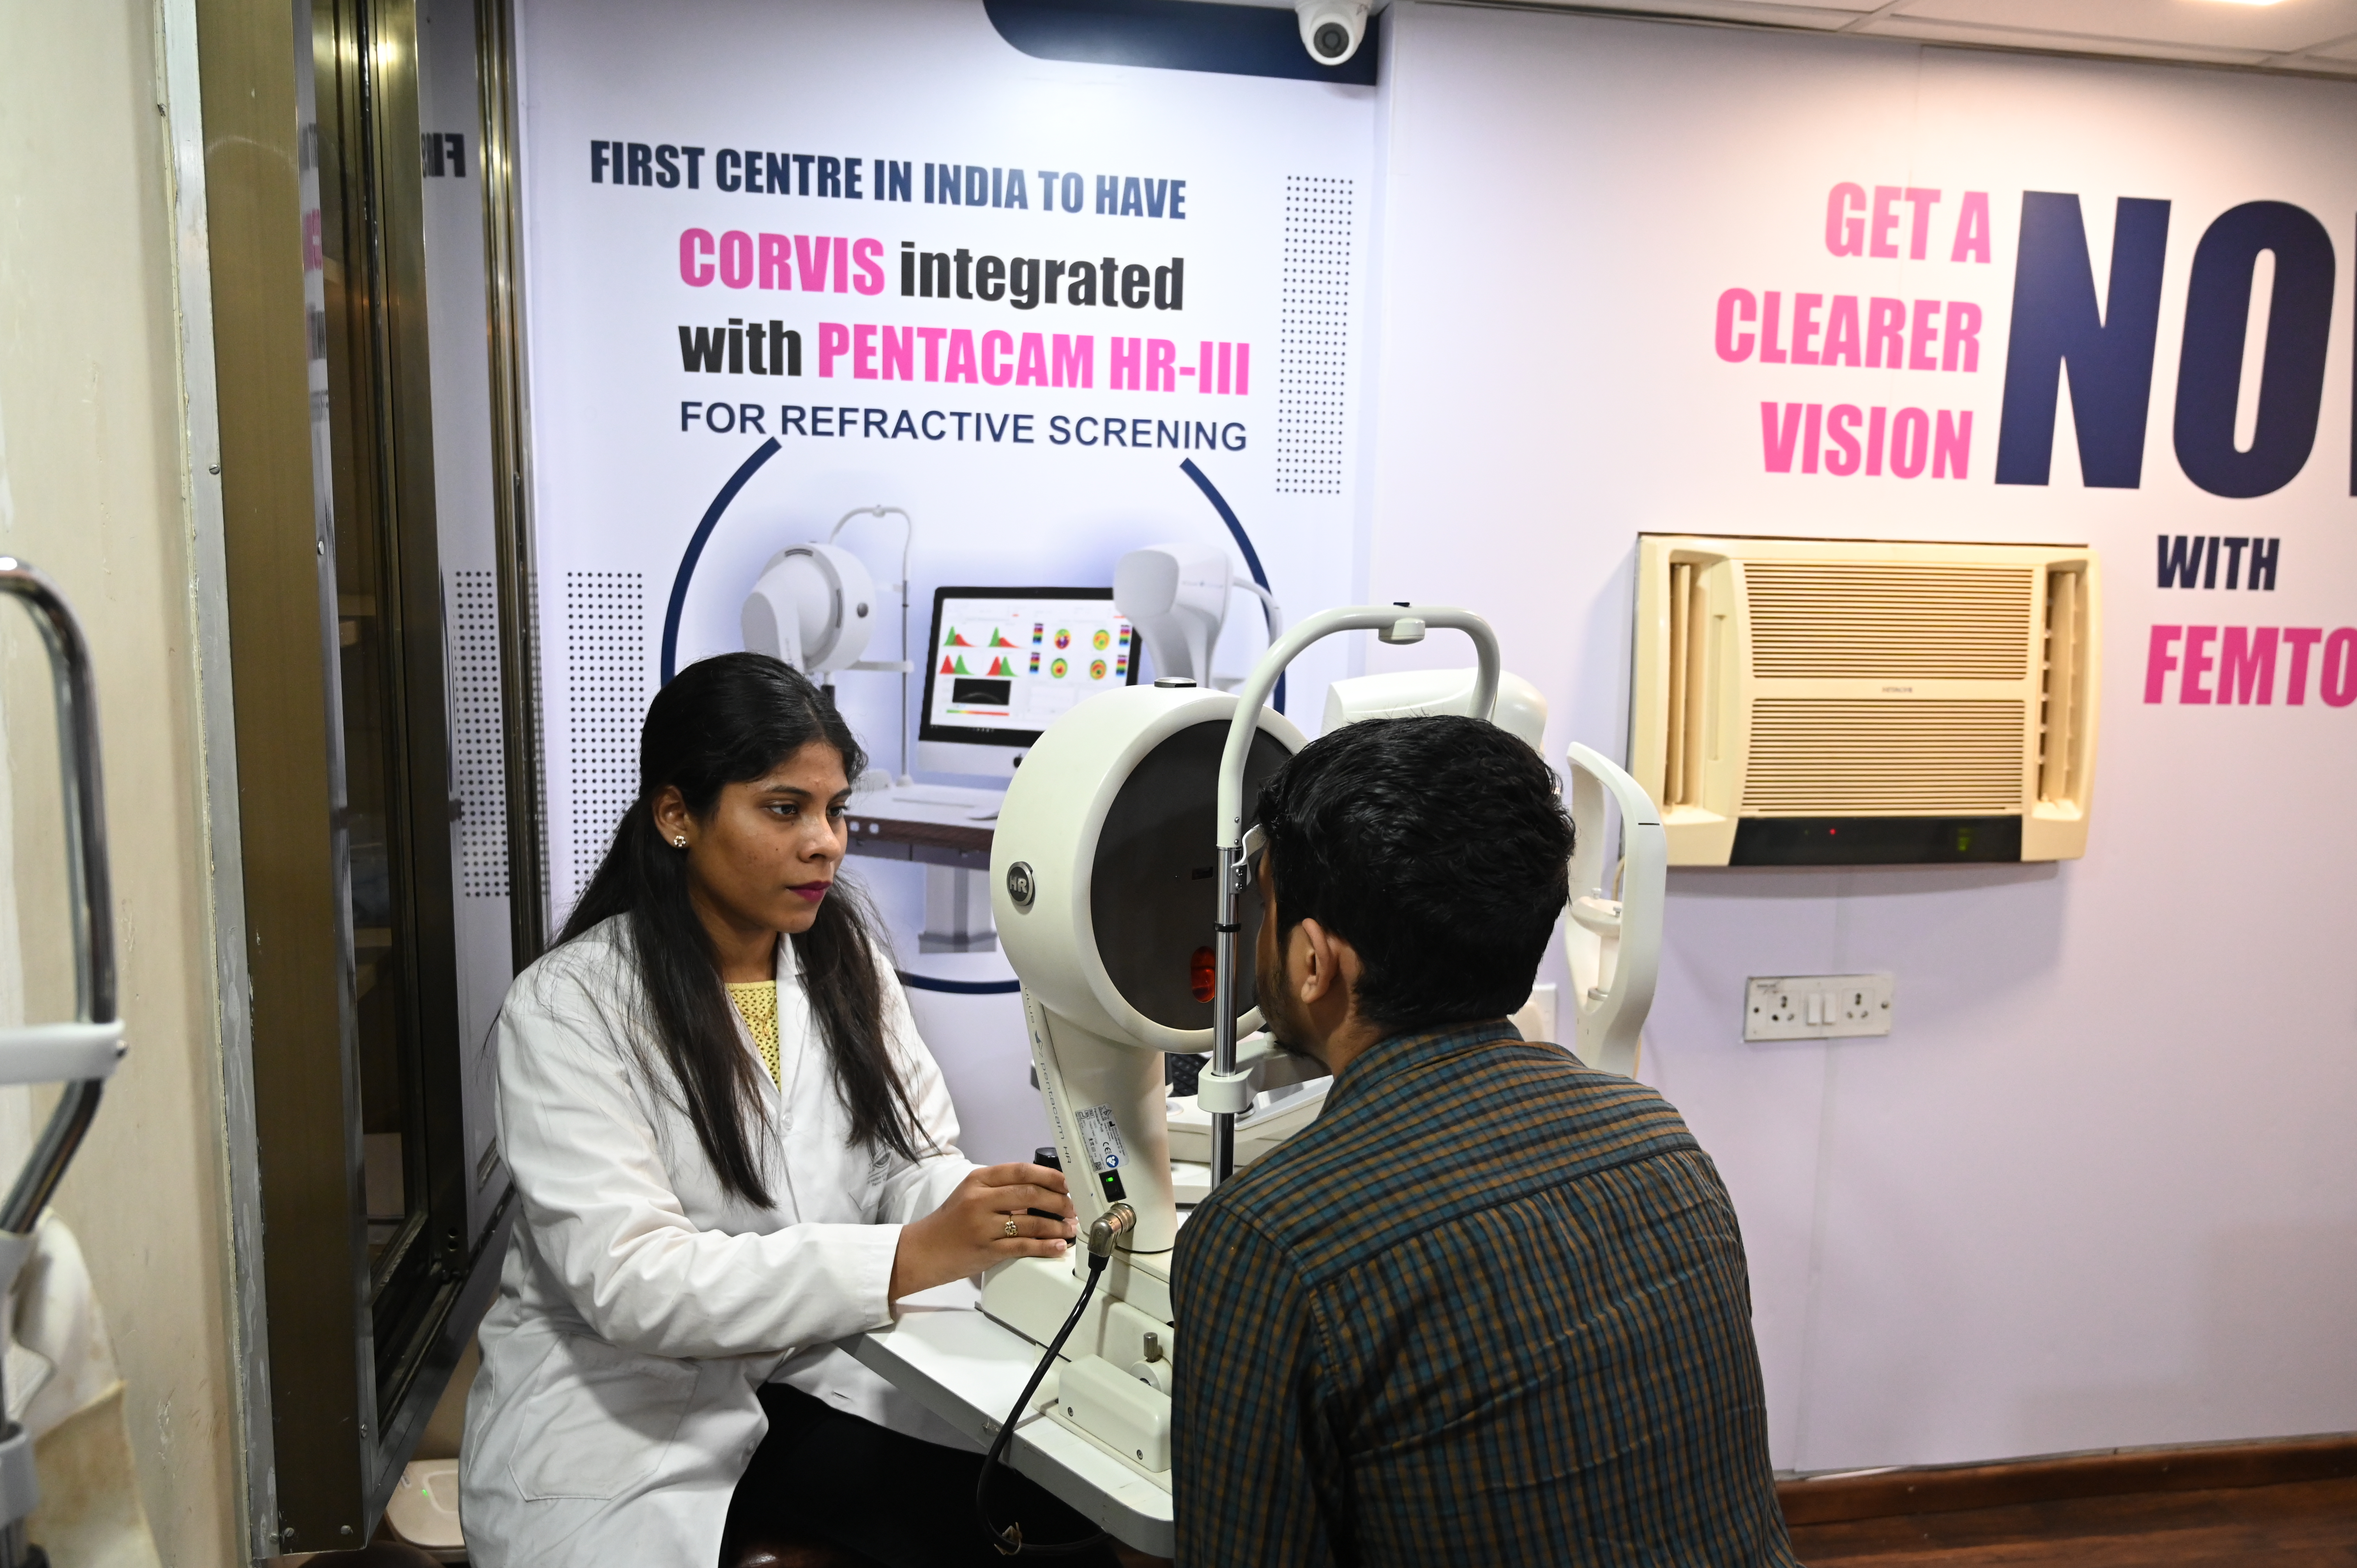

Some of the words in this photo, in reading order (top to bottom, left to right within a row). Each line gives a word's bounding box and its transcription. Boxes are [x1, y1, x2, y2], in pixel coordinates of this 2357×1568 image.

[590, 139, 706, 190] FIRST
[716, 148, 863, 200] CENTRE
[875, 159, 912, 202] IN
[924, 162, 1028, 209] INDIA
[1038, 170, 1083, 214] TO
[1096, 175, 1186, 219] HAVE
[1825, 182, 1941, 261] GET
[1950, 191, 1991, 264] A
[680, 228, 885, 297] CORVIS
[901, 241, 1184, 310] integrated
[678, 318, 802, 376] with
[818, 322, 1094, 389] PENTACAM
[1110, 336, 1250, 396] HR-III
[1714, 287, 1982, 373] CLEARER
[1995, 191, 2357, 498] NO
[681, 401, 766, 434] FOR
[782, 405, 1034, 443] REFRACTIVE
[1049, 415, 1246, 451] SCRENING
[1760, 401, 1974, 480] VISION
[2157, 535, 2280, 591] WITH
[2143, 623, 2357, 708] FEMTO
[1009, 875, 1028, 893] HR
[1025, 987, 1035, 1024] ULUS
[1040, 1062, 1065, 1140] pentacam
[1063, 1146, 1072, 1164] HR
